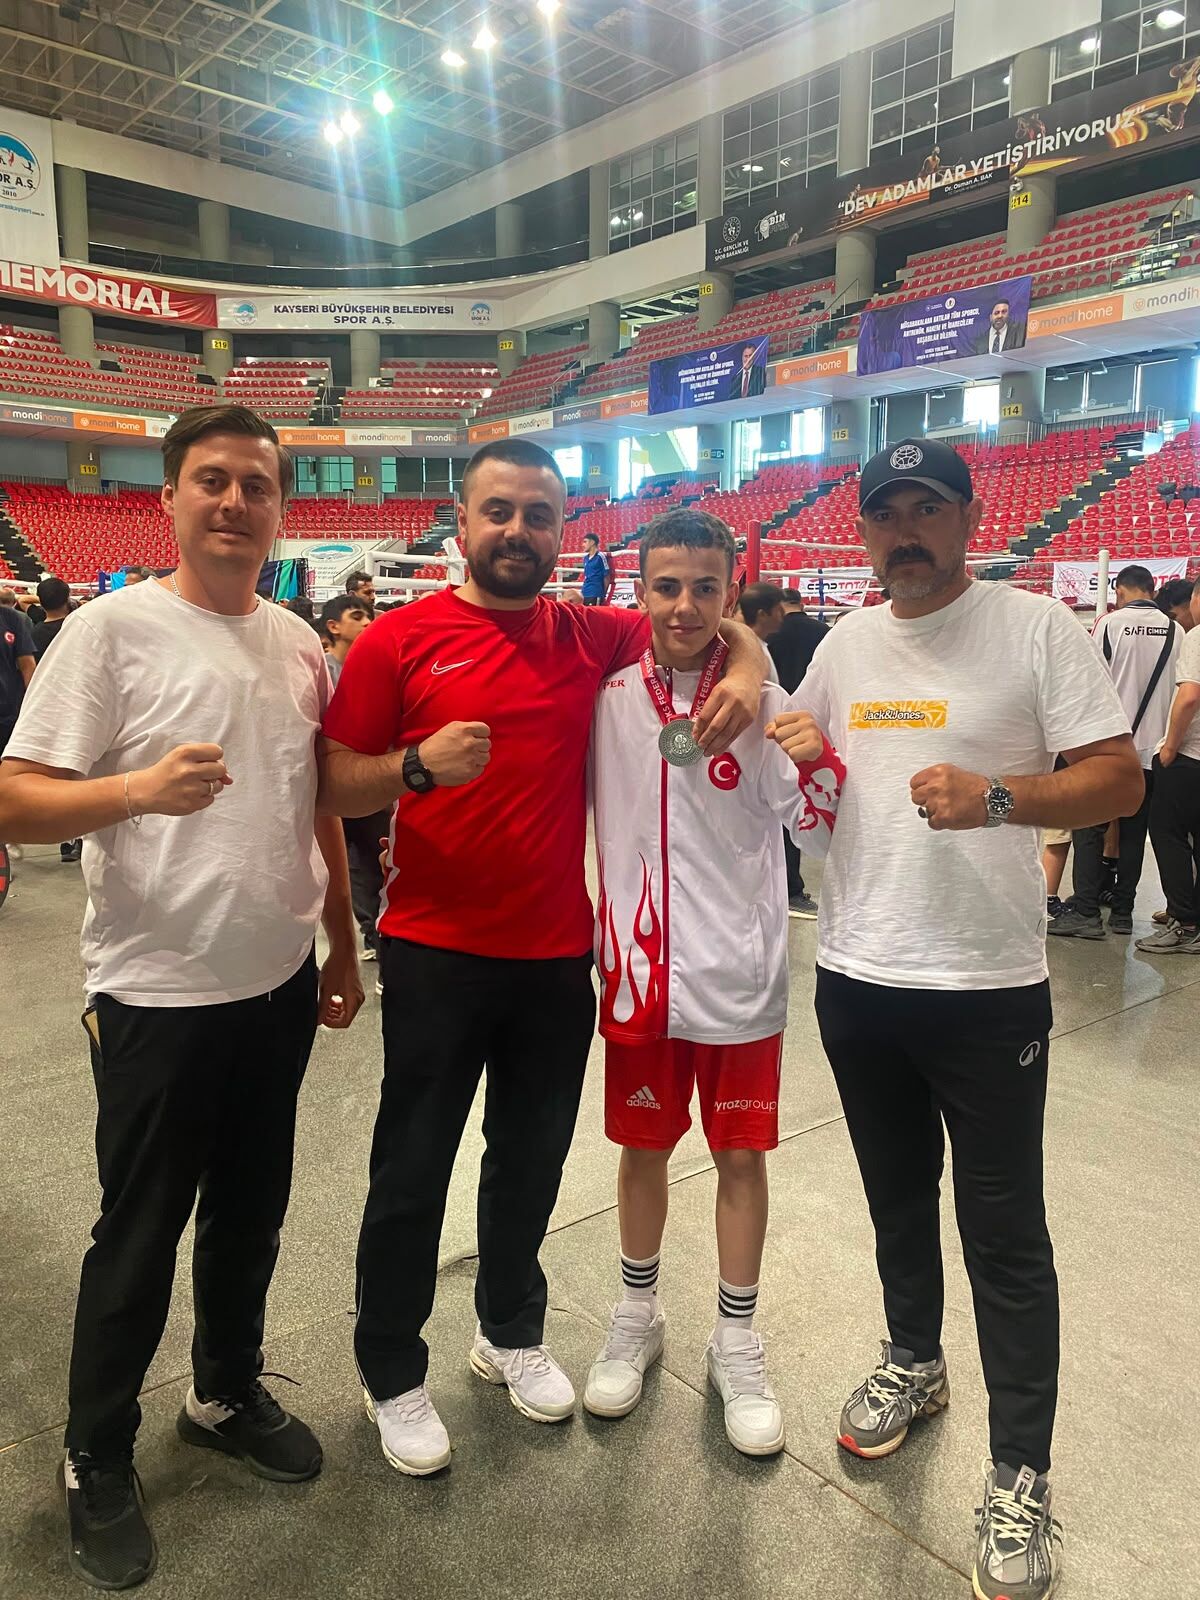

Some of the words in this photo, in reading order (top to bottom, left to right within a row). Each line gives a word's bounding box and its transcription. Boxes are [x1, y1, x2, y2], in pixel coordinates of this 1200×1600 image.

[881, 164, 967, 204] ADAMLAR
[714, 247, 723, 255] T.C.
[723, 241, 743, 253] GENÇLİK
[714, 252, 726, 261] SPOR
[726, 246, 749, 258] BAKANLIĞI
[274, 304, 319, 313] KAYSERİ
[322, 303, 390, 315] BÜYÜKŞEHİR
[393, 305, 454, 314] BELEDİYESİ
[334, 315, 367, 324] SPOR
[372, 315, 395, 326] A.Ş.
[1039, 305, 1113, 328] mondihome
[214, 340, 227, 349] 219
[500, 341, 512, 349] 217
[790, 359, 842, 377] mondihome
[1003, 405, 1019, 416] 114
[13, 410, 68, 423] mondihome
[89, 419, 141, 431] mondihome
[292, 433, 340, 441] mondihome
[359, 432, 406, 441] mondihome
[83, 466, 97, 474] 119
[626, 1099, 661, 1110] adidas
